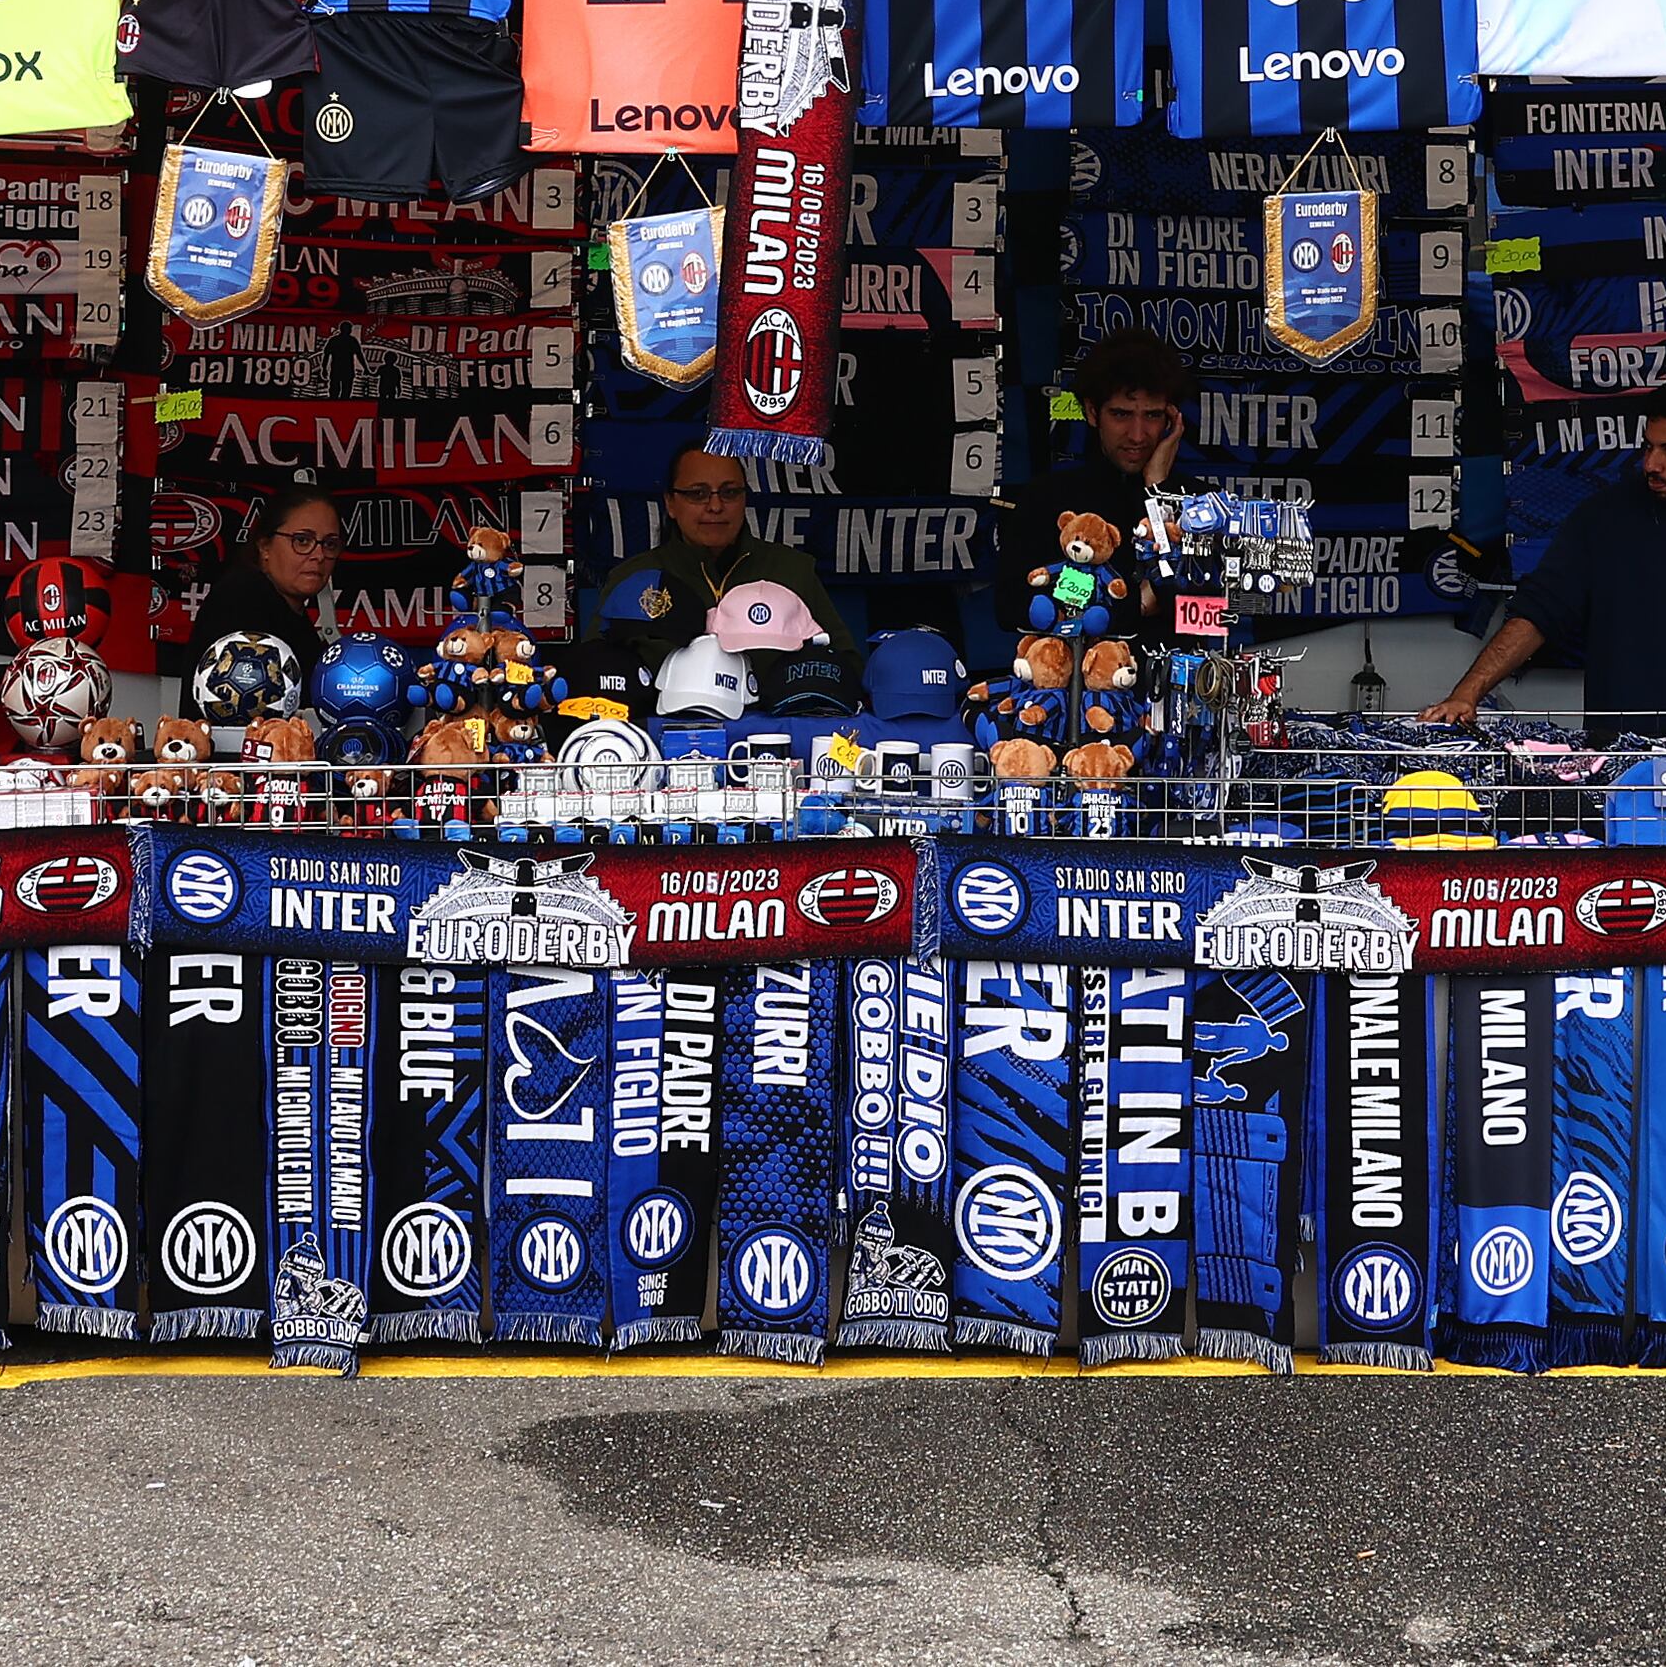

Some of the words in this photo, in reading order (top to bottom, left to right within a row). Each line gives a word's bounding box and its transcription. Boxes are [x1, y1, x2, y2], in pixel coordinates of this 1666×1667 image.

[924, 61, 1079, 100] Lenovo
[1238, 45, 1405, 84] Lenovo
[1526, 104, 1557, 133] FC
[194, 157, 253, 178] Euroderby
[742, 149, 797, 295] MILAN
[792, 163, 823, 290] 16/05/2023
[1295, 200, 1347, 218] Euroderby
[189, 326, 226, 351] AC
[233, 325, 316, 352] MILAN
[1200, 391, 1318, 450] INTER
[1415, 414, 1449, 438] 11
[209, 414, 298, 466] AC
[317, 415, 532, 469] MILAN
[43, 614, 86, 631] MILAN
[599, 675, 625, 691] INTER
[269, 858, 324, 881] STADIO
[329, 862, 359, 883] SAN
[363, 863, 401, 887] SIRO
[659, 868, 781, 895] 16/05/2023
[1441, 877, 1559, 902] 16/05/2023
[270, 887, 395, 934] INTER
[648, 898, 785, 941] MILAN
[1057, 897, 1183, 941] INTER
[1431, 905, 1564, 948] MILAN
[405, 918, 637, 965] EURODERBY
[1193, 927, 1421, 972] EURODERBY
[665, 983, 715, 1025] DI
[399, 1015, 454, 1103] BLUE
[1479, 988, 1527, 1148] MILANO
[613, 1038, 659, 1158] FIGLIO
[661, 1031, 714, 1153] PADRE
[638, 1273, 669, 1291] SINCE
[1103, 1278, 1162, 1297] STATI
[845, 1293, 894, 1318] GOBBO
[897, 1293, 913, 1315] TI
[913, 1292, 948, 1318] ODIO
